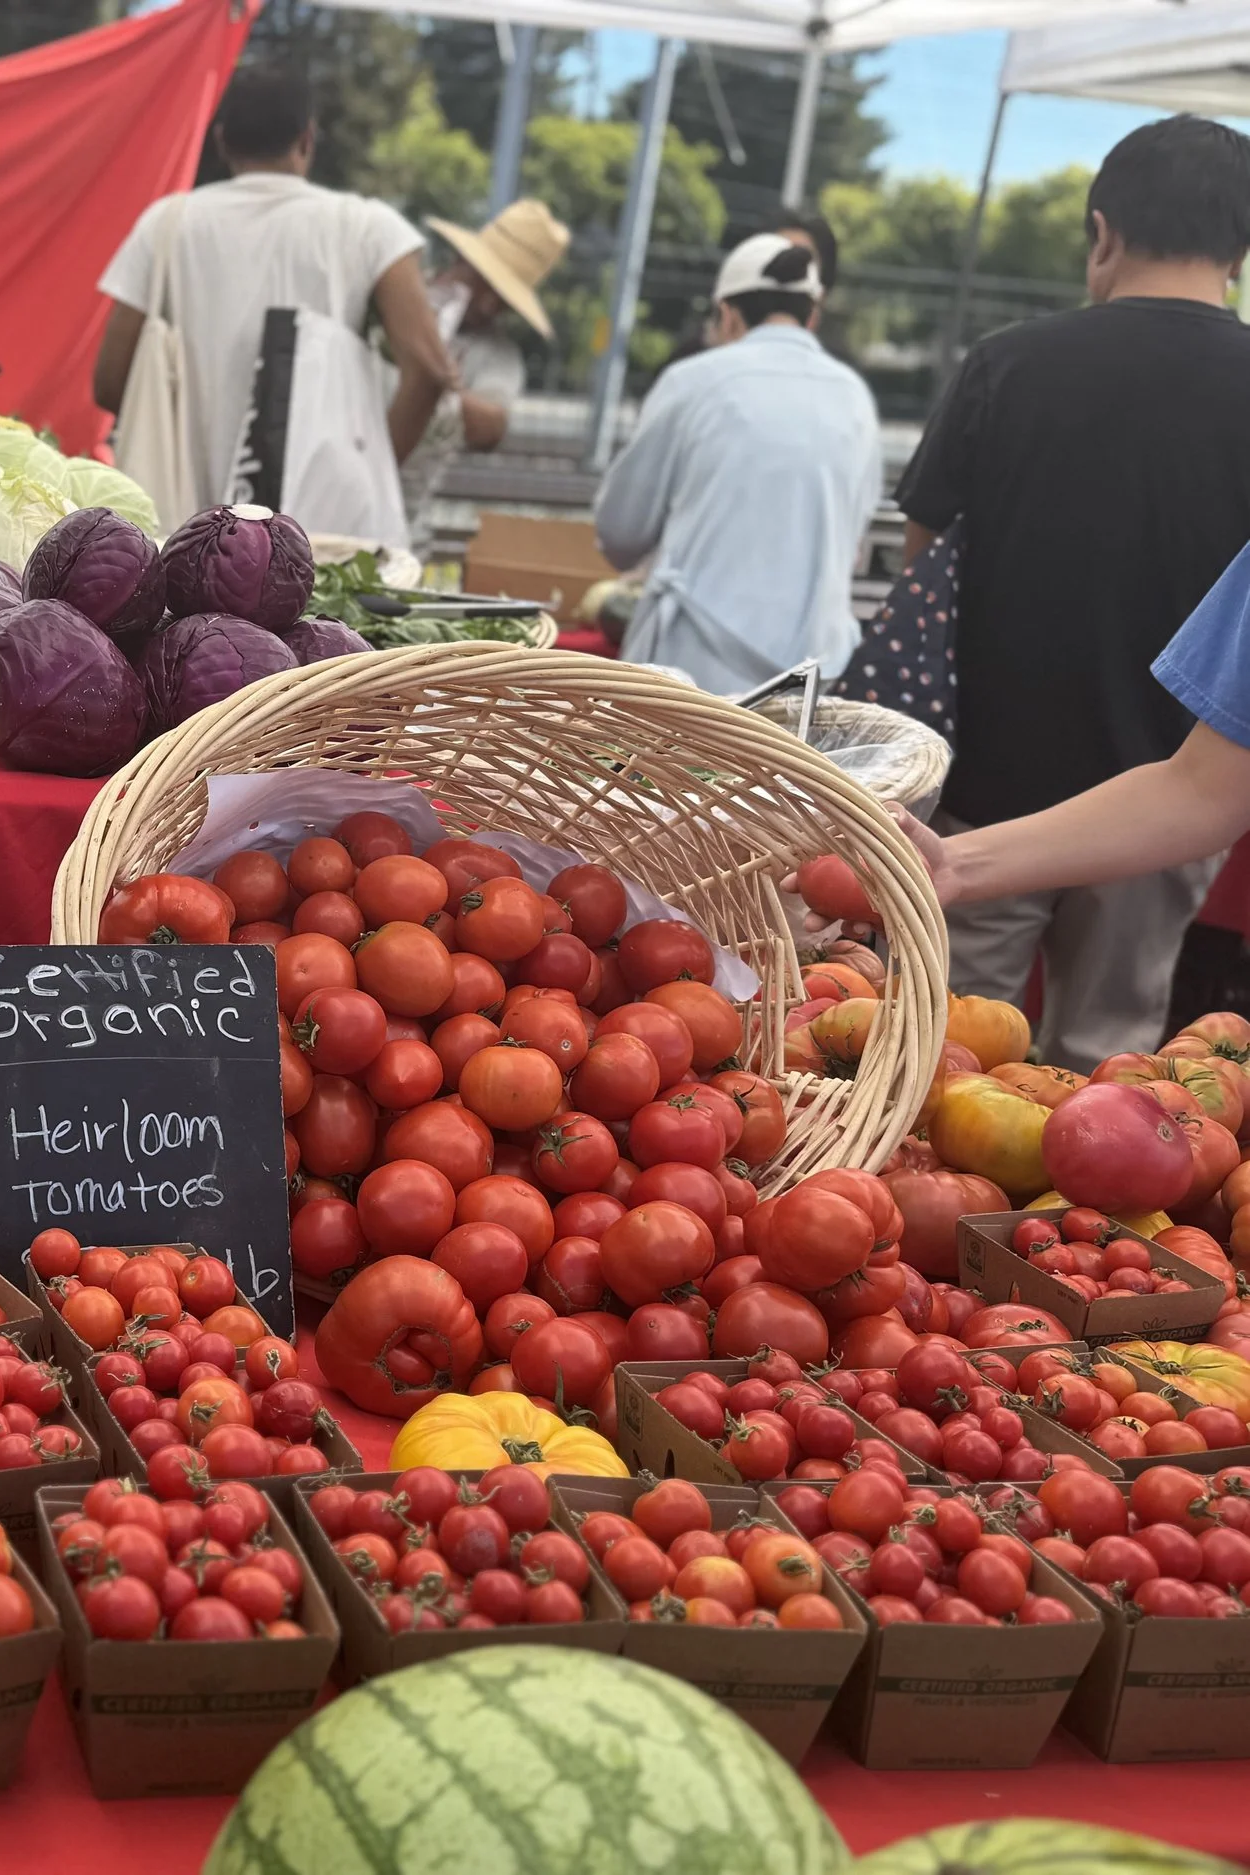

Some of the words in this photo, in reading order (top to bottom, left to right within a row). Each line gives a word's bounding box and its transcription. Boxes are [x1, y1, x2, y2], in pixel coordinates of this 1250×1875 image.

[9, 1099, 225, 1164] Heirloom
[1150, 1326, 1208, 1342] ORGANIC
[899, 1679, 976, 1692] CERTIFIED
[981, 1678, 1056, 1692] ORGANIC
